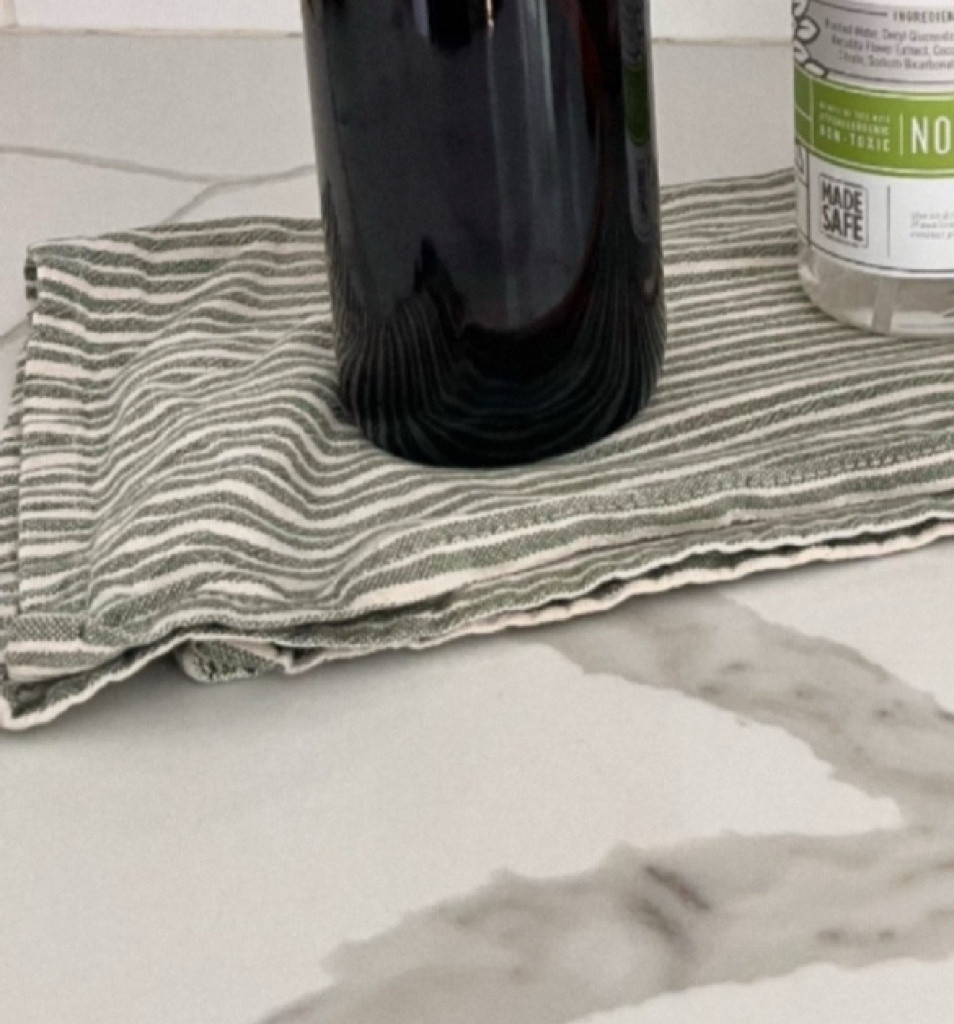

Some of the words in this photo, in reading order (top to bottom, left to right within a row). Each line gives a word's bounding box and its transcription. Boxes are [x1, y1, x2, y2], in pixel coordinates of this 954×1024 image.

[910, 114, 952, 155] NO
[821, 179, 863, 215] MADE
[821, 204, 864, 242] SAFE
